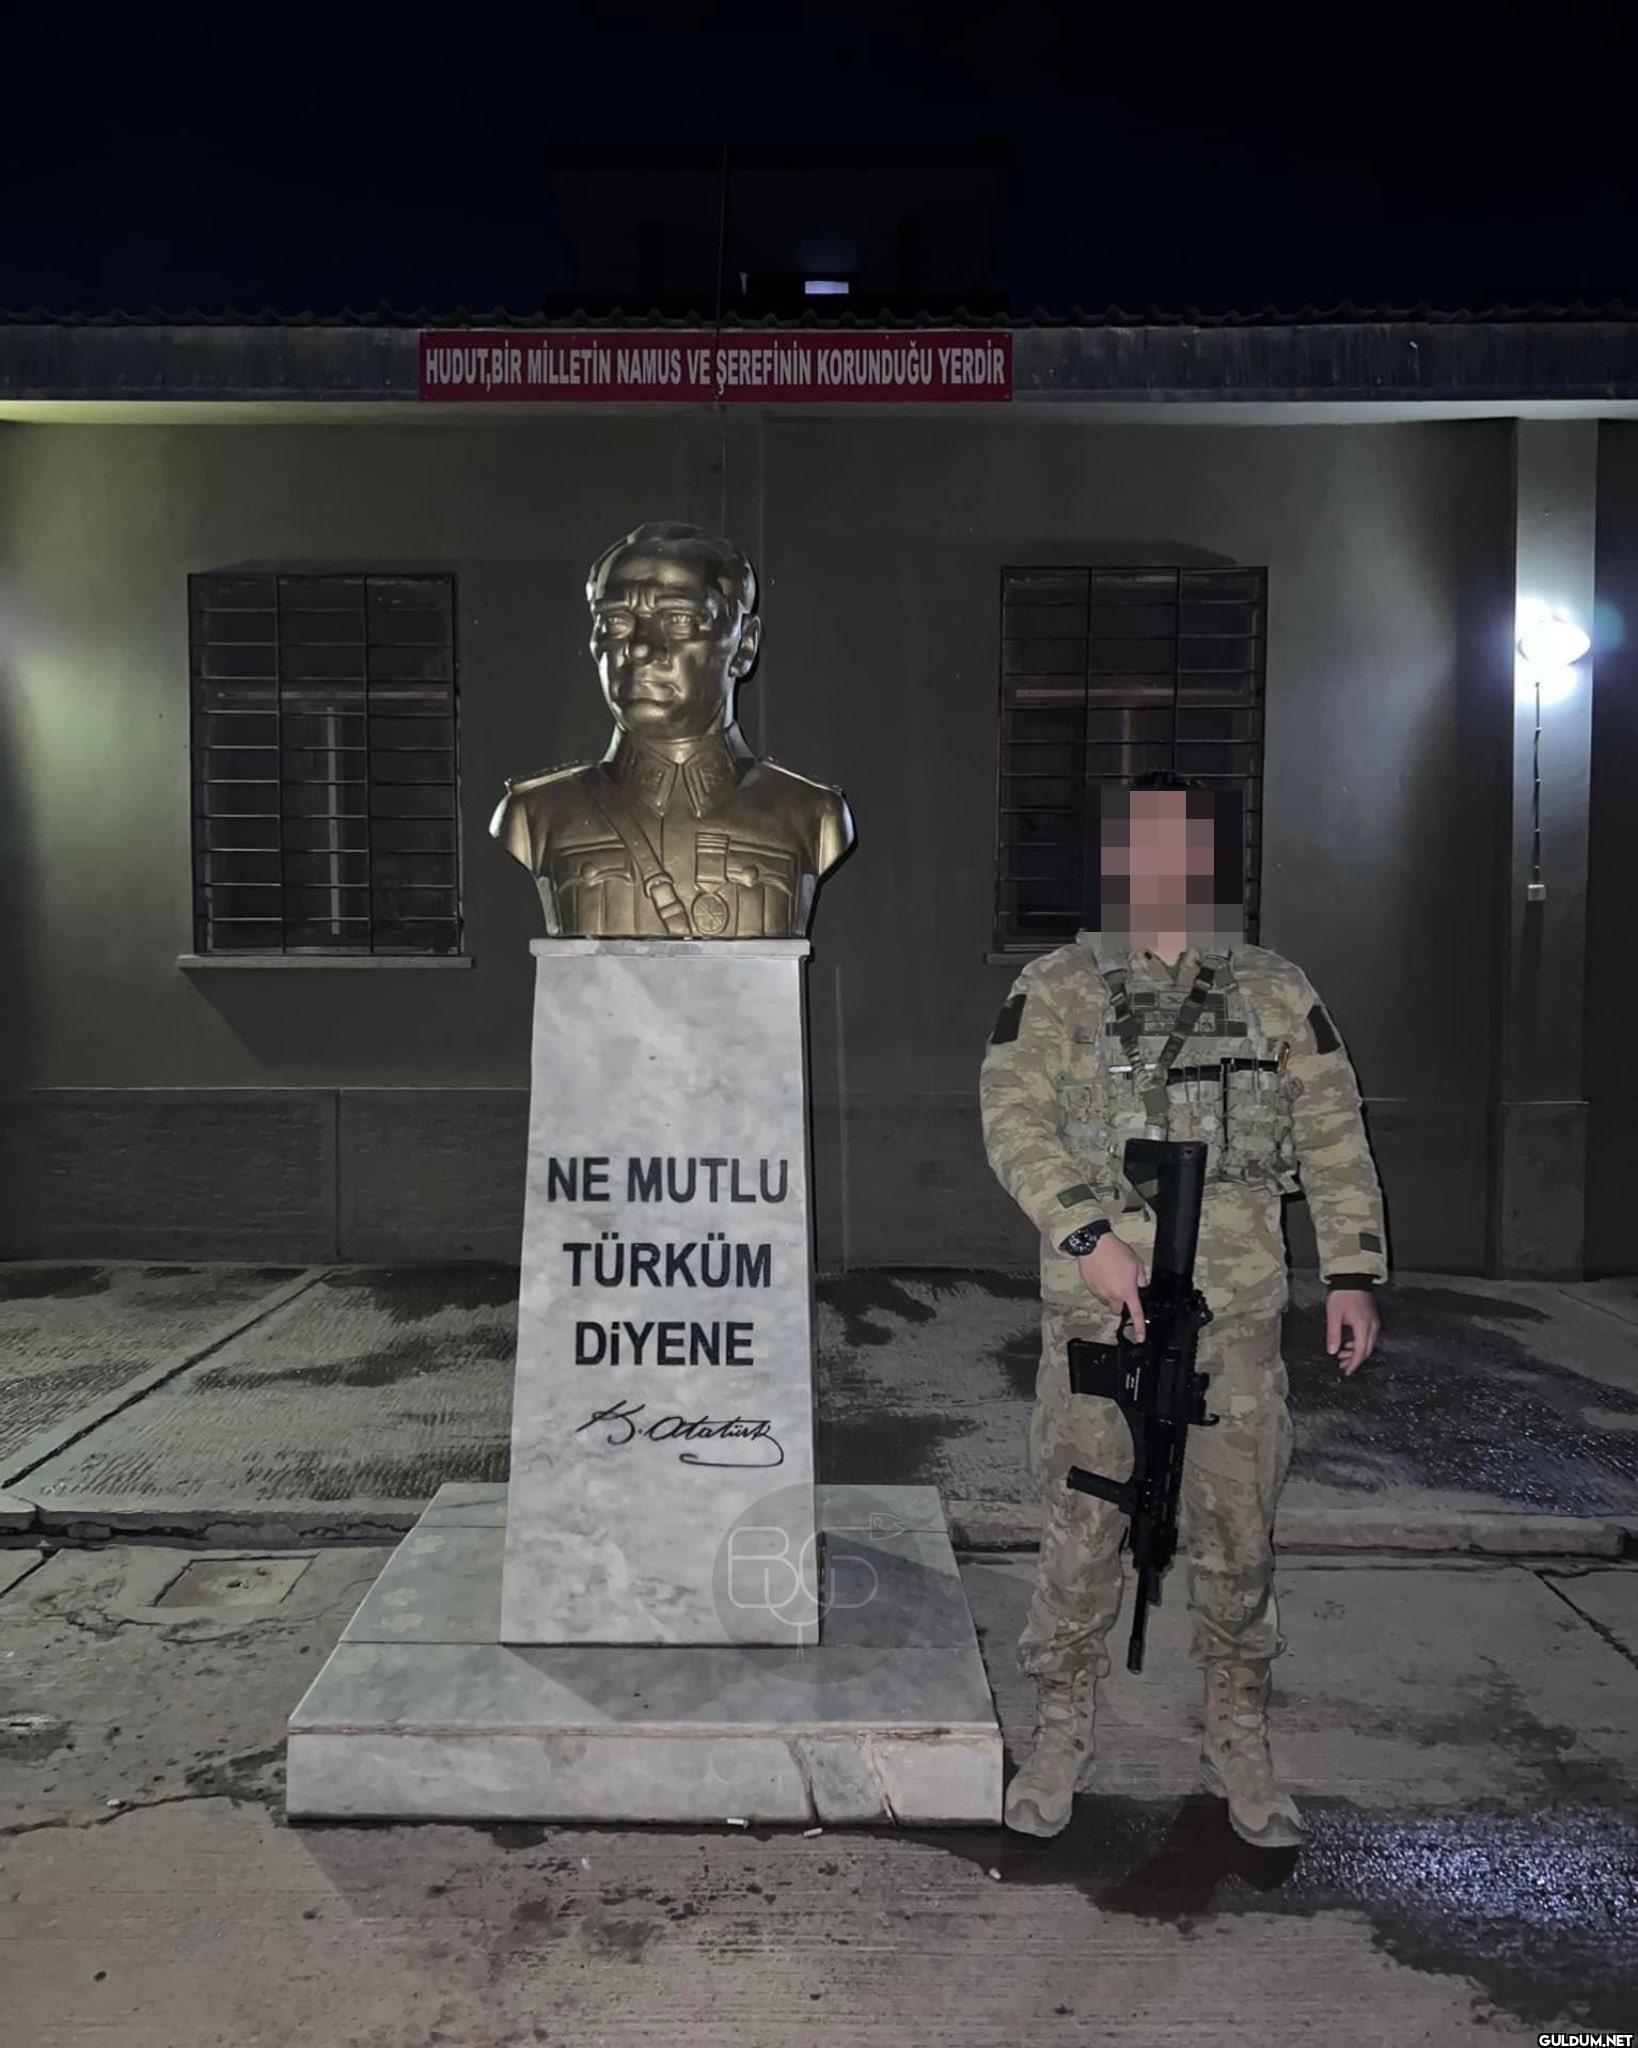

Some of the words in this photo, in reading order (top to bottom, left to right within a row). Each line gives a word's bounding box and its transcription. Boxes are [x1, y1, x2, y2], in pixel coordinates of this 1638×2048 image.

[425, 339, 522, 392] HUDUT,BİR
[528, 339, 611, 385] MİLLETİN
[617, 348, 682, 385] NAMUS
[687, 348, 711, 385] VE
[715, 340, 811, 395] ŞEREFİNİN
[817, 340, 933, 385] KORUNDUĞU
[937, 338, 1005, 385] YERDİR
[548, 1156, 610, 1203] NE
[627, 1157, 788, 1203] MUTLU
[562, 1231, 772, 1288] TÜRKÜM
